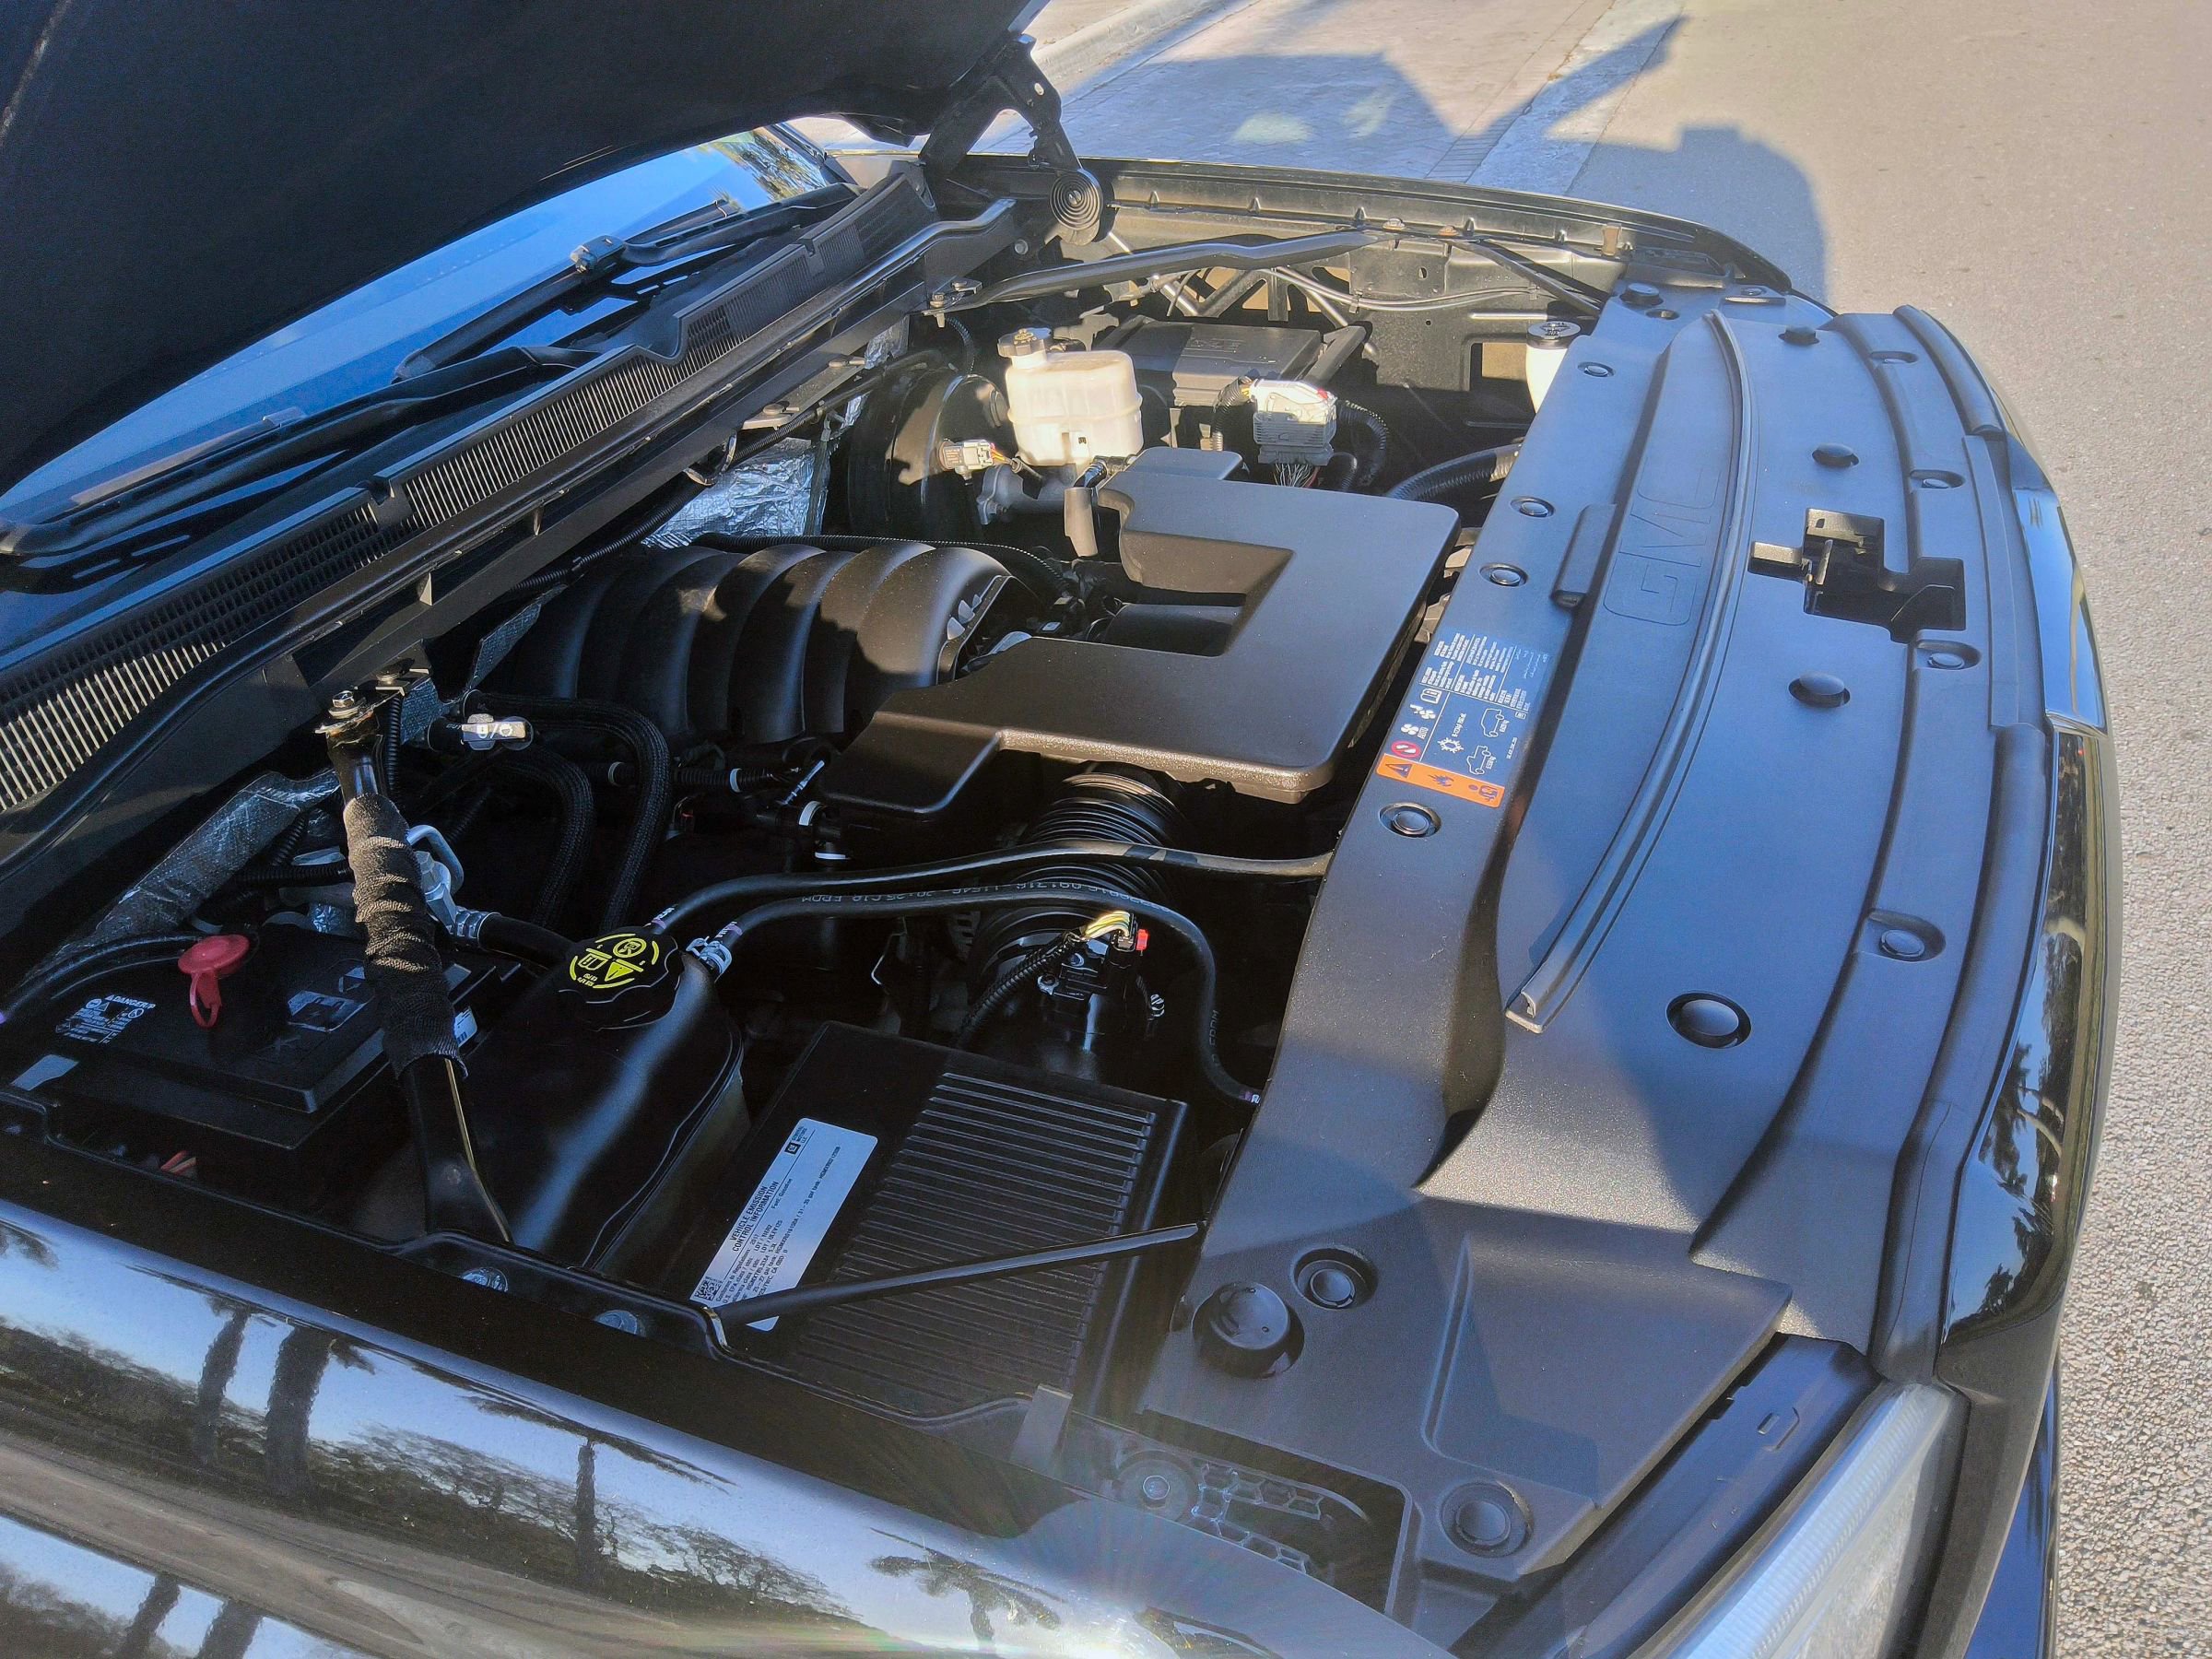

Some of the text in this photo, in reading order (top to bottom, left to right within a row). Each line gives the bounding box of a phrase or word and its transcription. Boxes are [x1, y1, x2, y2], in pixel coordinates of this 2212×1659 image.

[1603, 461, 1721, 627] GMC
[728, 1185, 769, 1241] VEHICLE EMISSION
[730, 1180, 780, 1252] CONTROL INFORMATION
